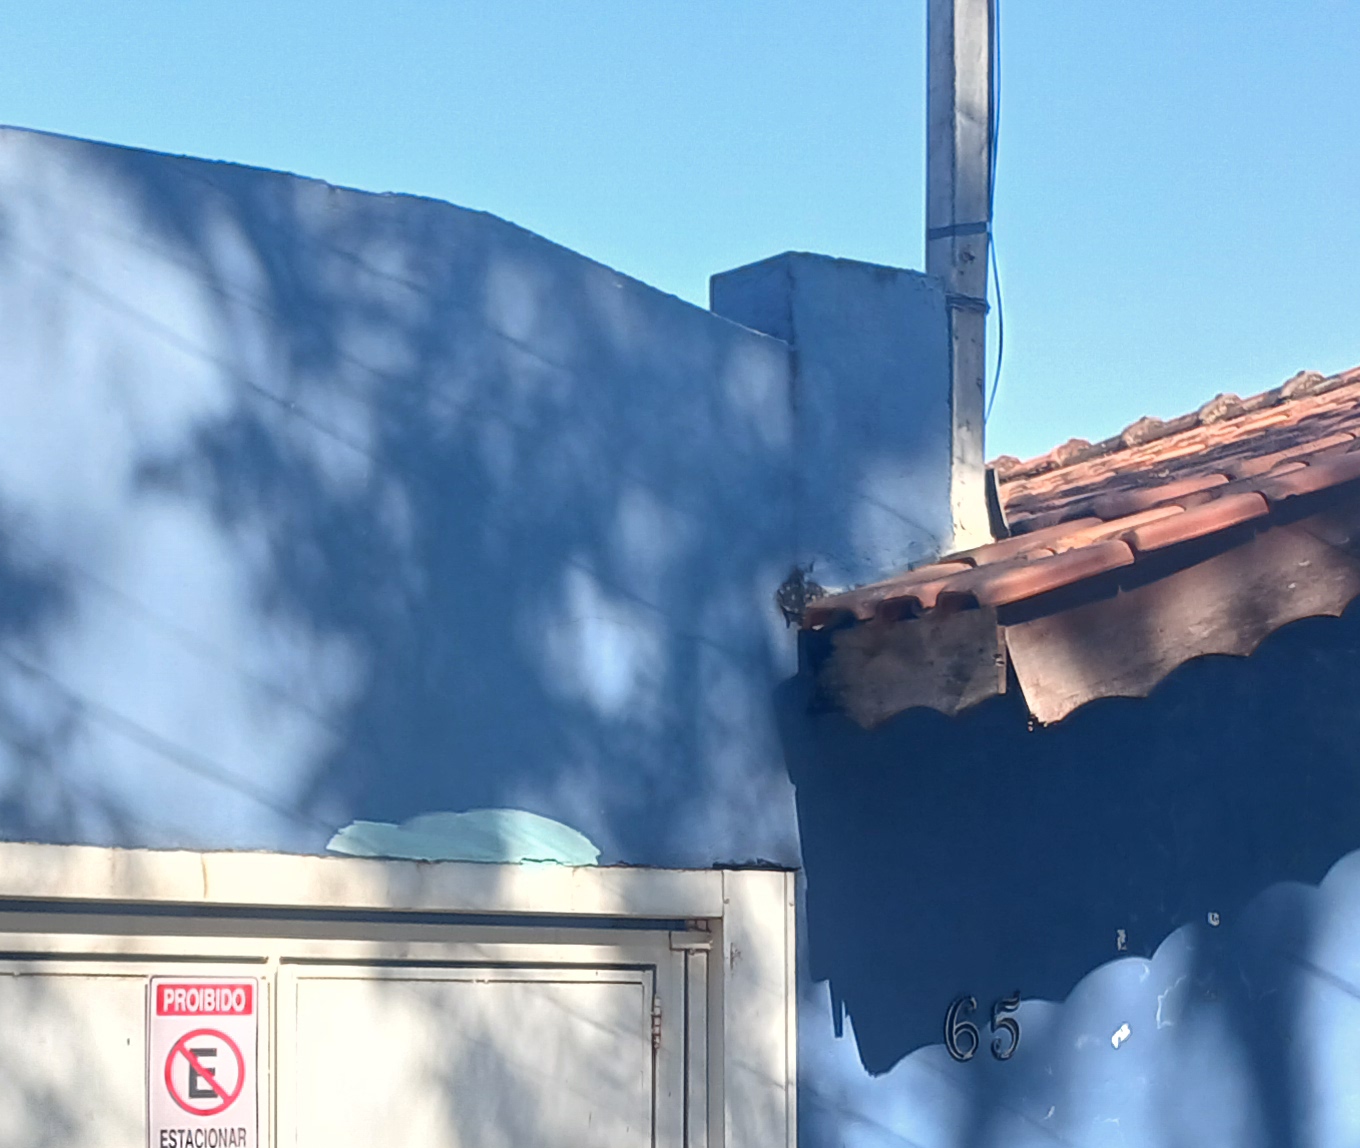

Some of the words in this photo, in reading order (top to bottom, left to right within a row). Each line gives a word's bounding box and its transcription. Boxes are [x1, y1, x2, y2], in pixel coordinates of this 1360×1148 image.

[163, 988, 246, 1012] PROIBIDO
[944, 992, 1020, 1063] 65
[188, 1048, 218, 1099] E
